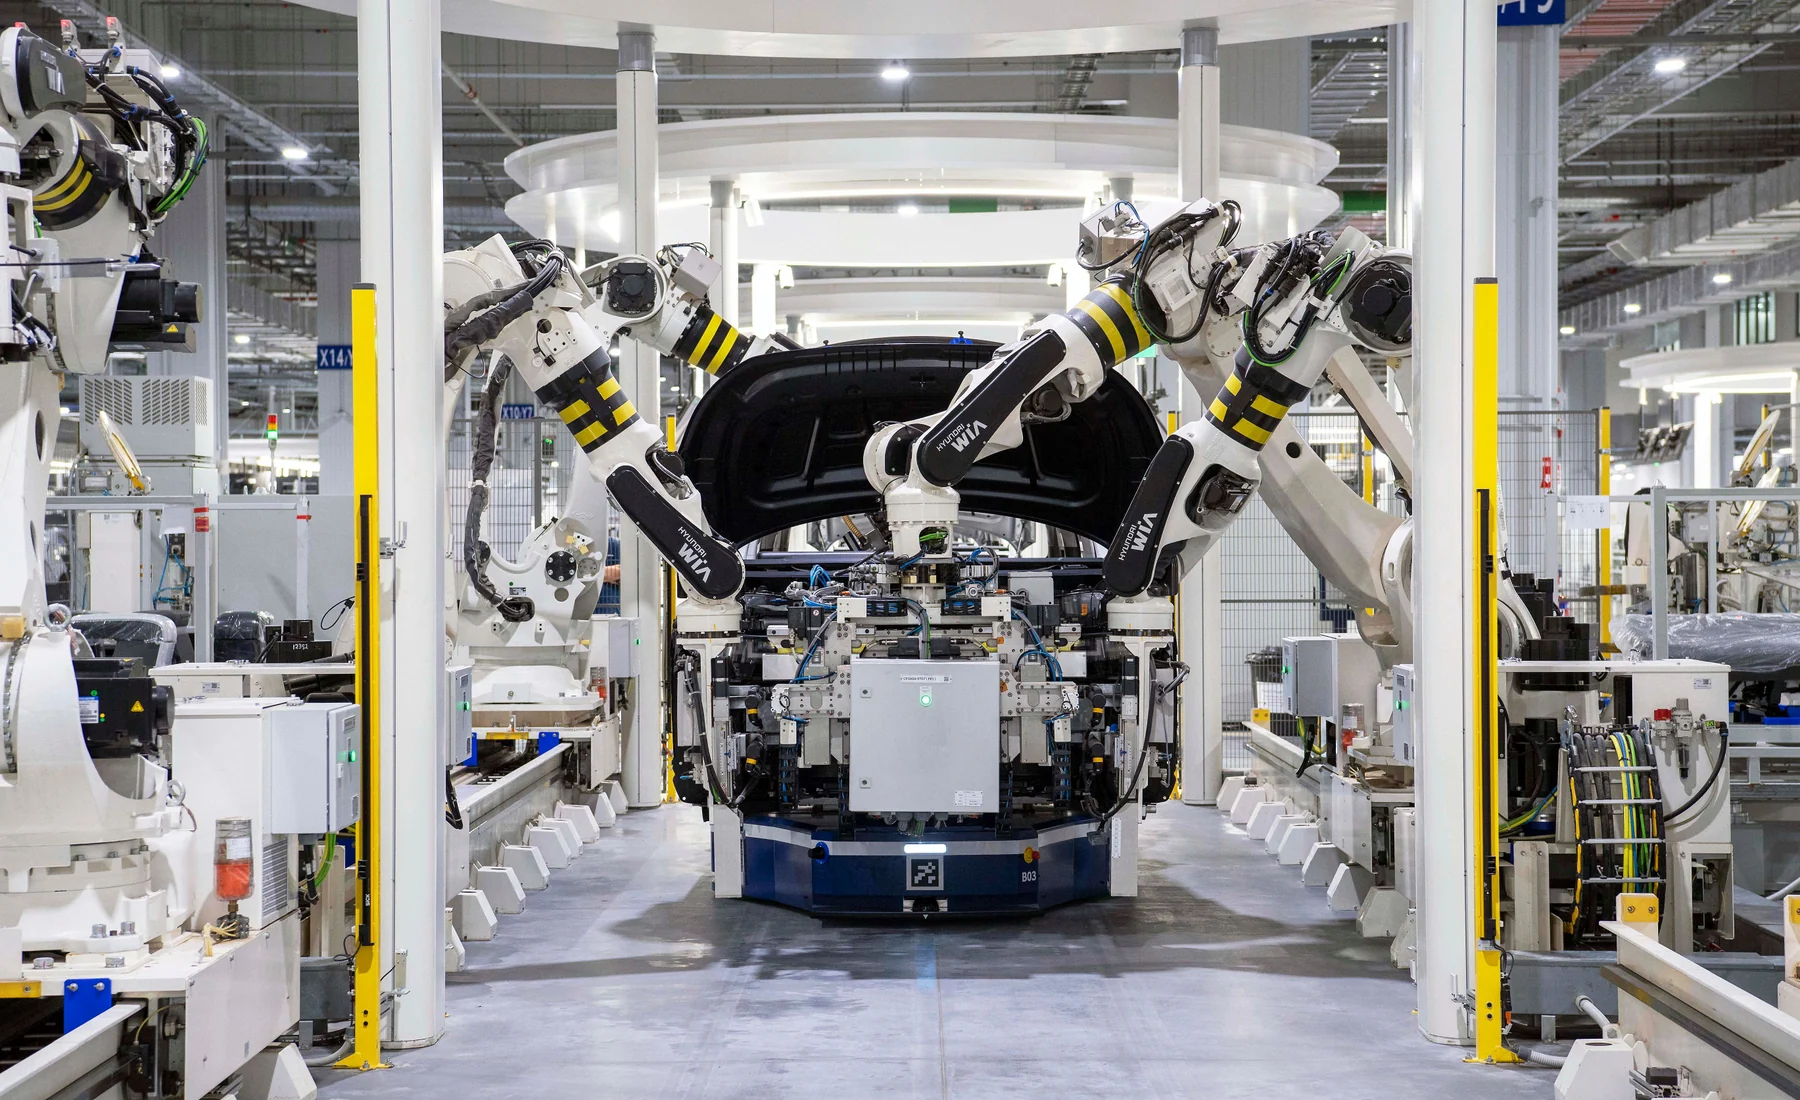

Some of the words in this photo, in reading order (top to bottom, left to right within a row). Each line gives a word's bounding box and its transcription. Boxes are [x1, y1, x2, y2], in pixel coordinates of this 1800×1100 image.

[936, 423, 965, 452] HYUNDAI
[677, 526, 707, 558] HYUNDAI
[1118, 524, 1137, 561] HYUNDAI
[1021, 870, 1037, 882] B03
